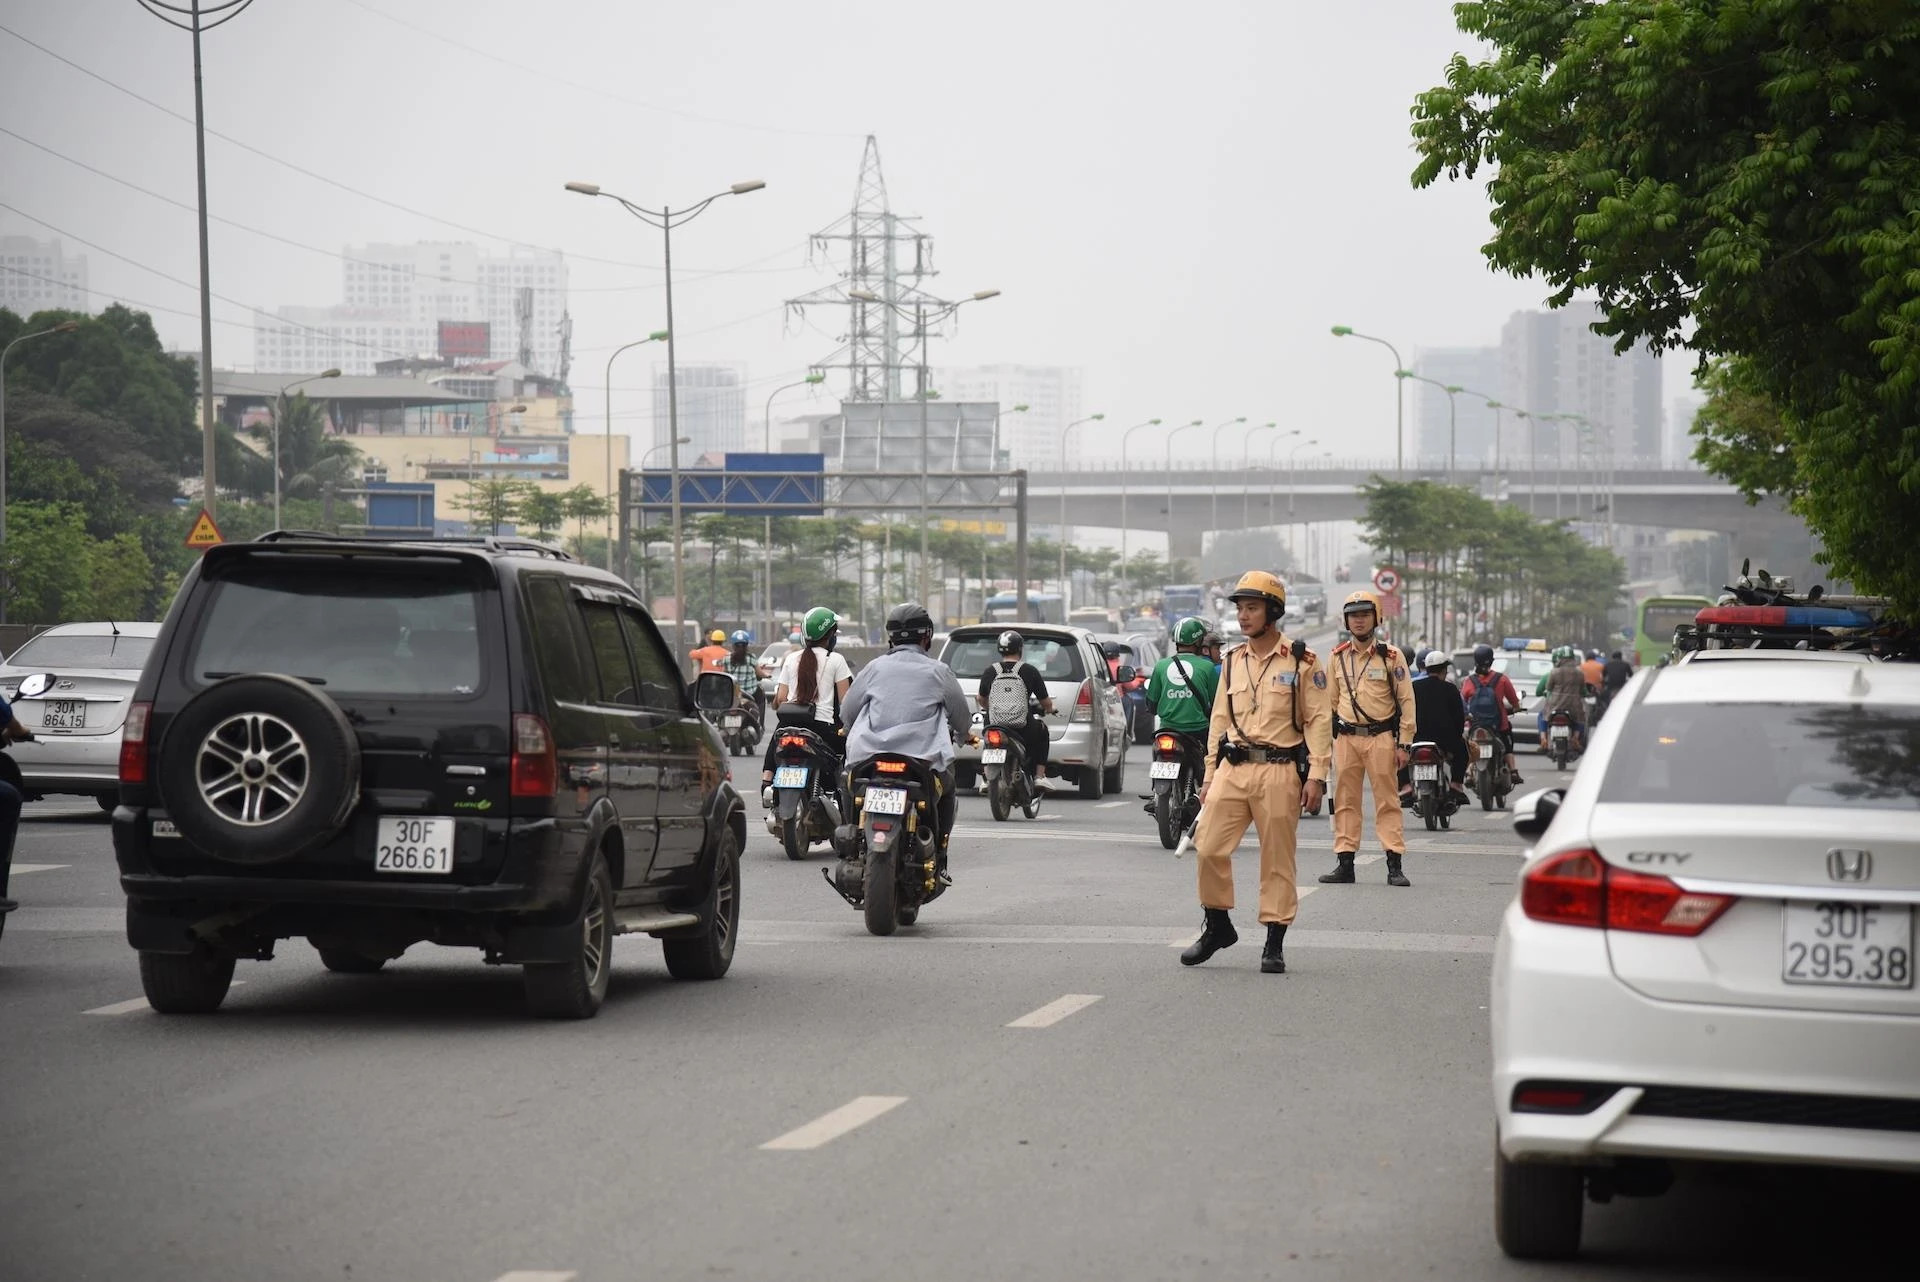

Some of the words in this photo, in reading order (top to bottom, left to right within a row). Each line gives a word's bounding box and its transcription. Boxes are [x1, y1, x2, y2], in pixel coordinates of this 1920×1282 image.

[818, 618, 831, 631] Grab
[1167, 686, 1193, 699] Grab
[54, 701, 75, 714] 30A
[44, 714, 82, 727] 864.15
[867, 800, 901, 813] 749.13
[396, 820, 435, 844] 30F
[378, 845, 447, 869] 266.61
[1627, 851, 1692, 866] CITY
[1815, 902, 1881, 940] 30F
[1789, 942, 1907, 982] 295.38
